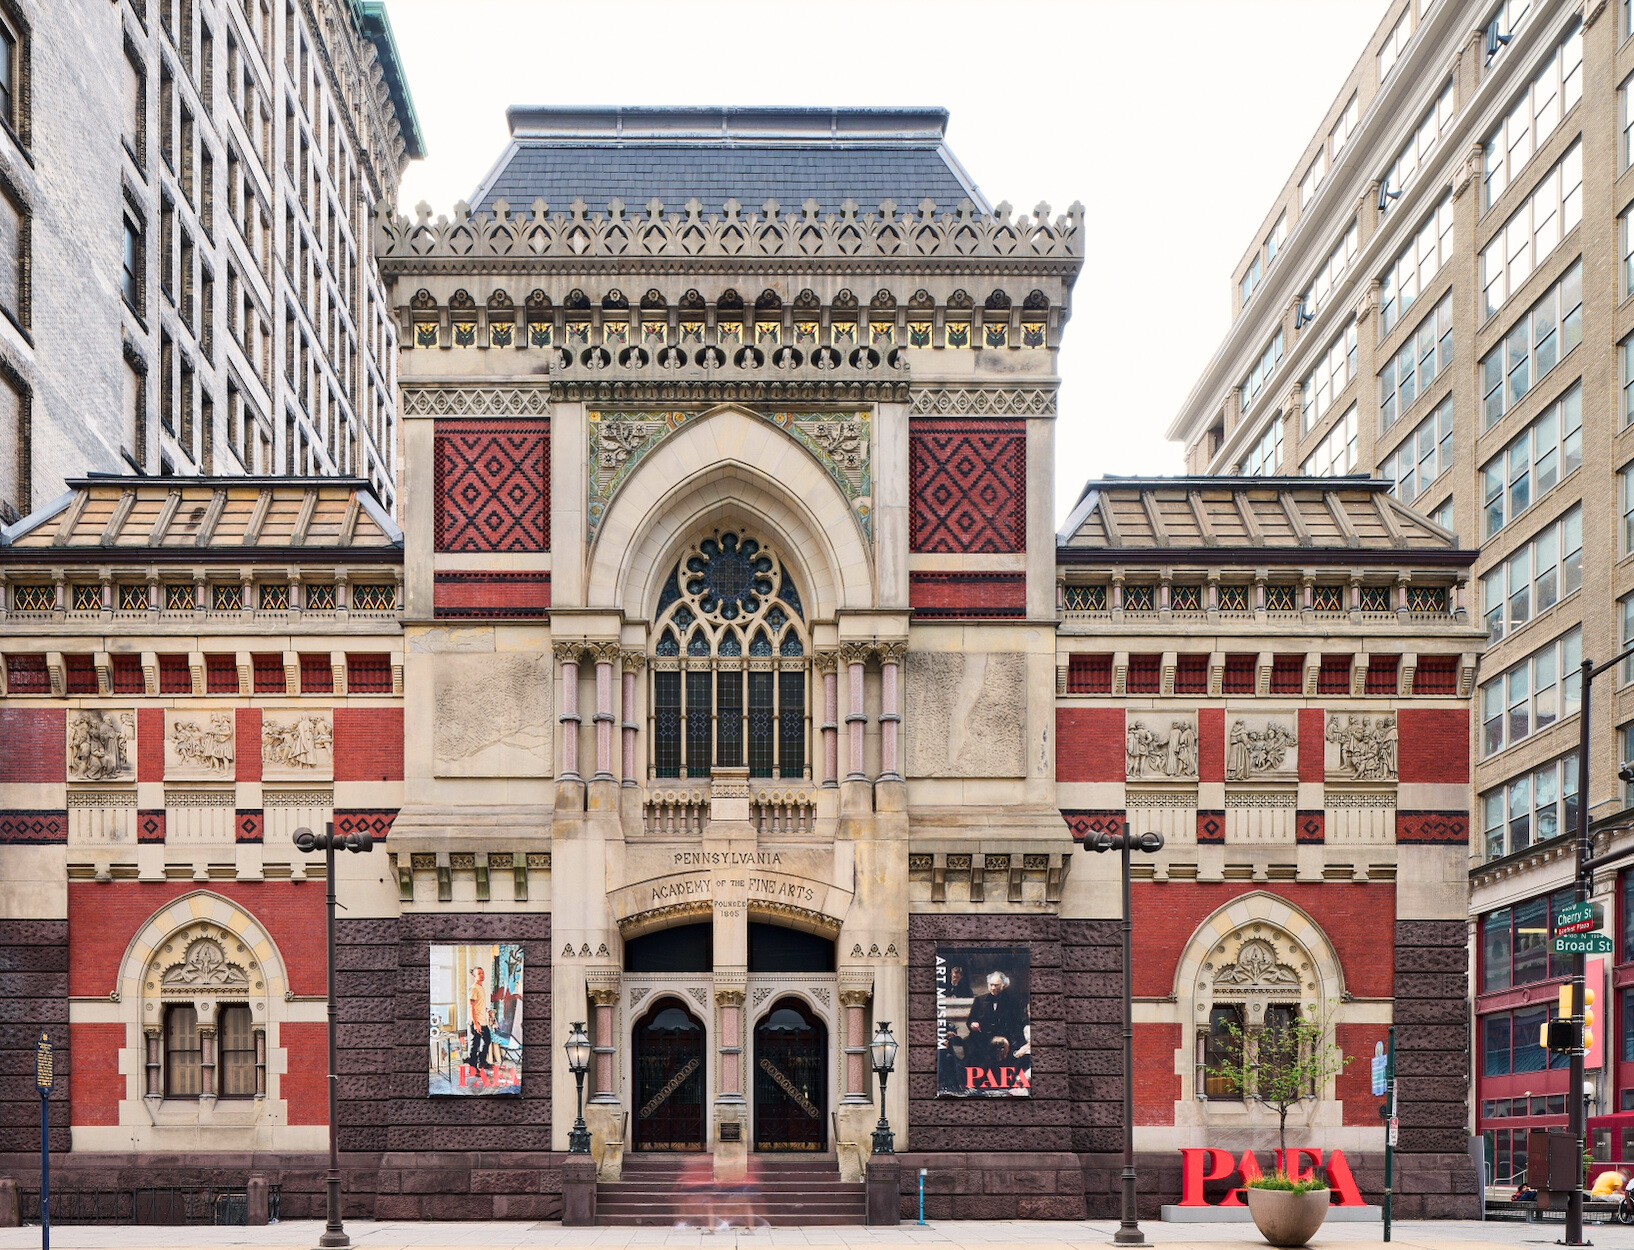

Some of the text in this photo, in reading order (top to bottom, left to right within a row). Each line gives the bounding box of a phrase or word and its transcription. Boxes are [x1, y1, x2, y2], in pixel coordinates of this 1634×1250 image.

[674, 852, 782, 865] PENNSYLVANIA
[651, 879, 711, 901] ACADEMY
[730, 879, 745, 887] THE
[748, 878, 776, 893] FINE
[778, 883, 815, 901] ARTS
[714, 900, 747, 908] FOUNDED
[1557, 911, 1582, 926] Cherry
[1584, 908, 1592, 919] St
[1556, 939, 1611, 951] Broad St
[935, 955, 947, 1050] ART MUSEUM
[458, 1065, 521, 1089] PAFA
[965, 1066, 1032, 1089] PAFA
